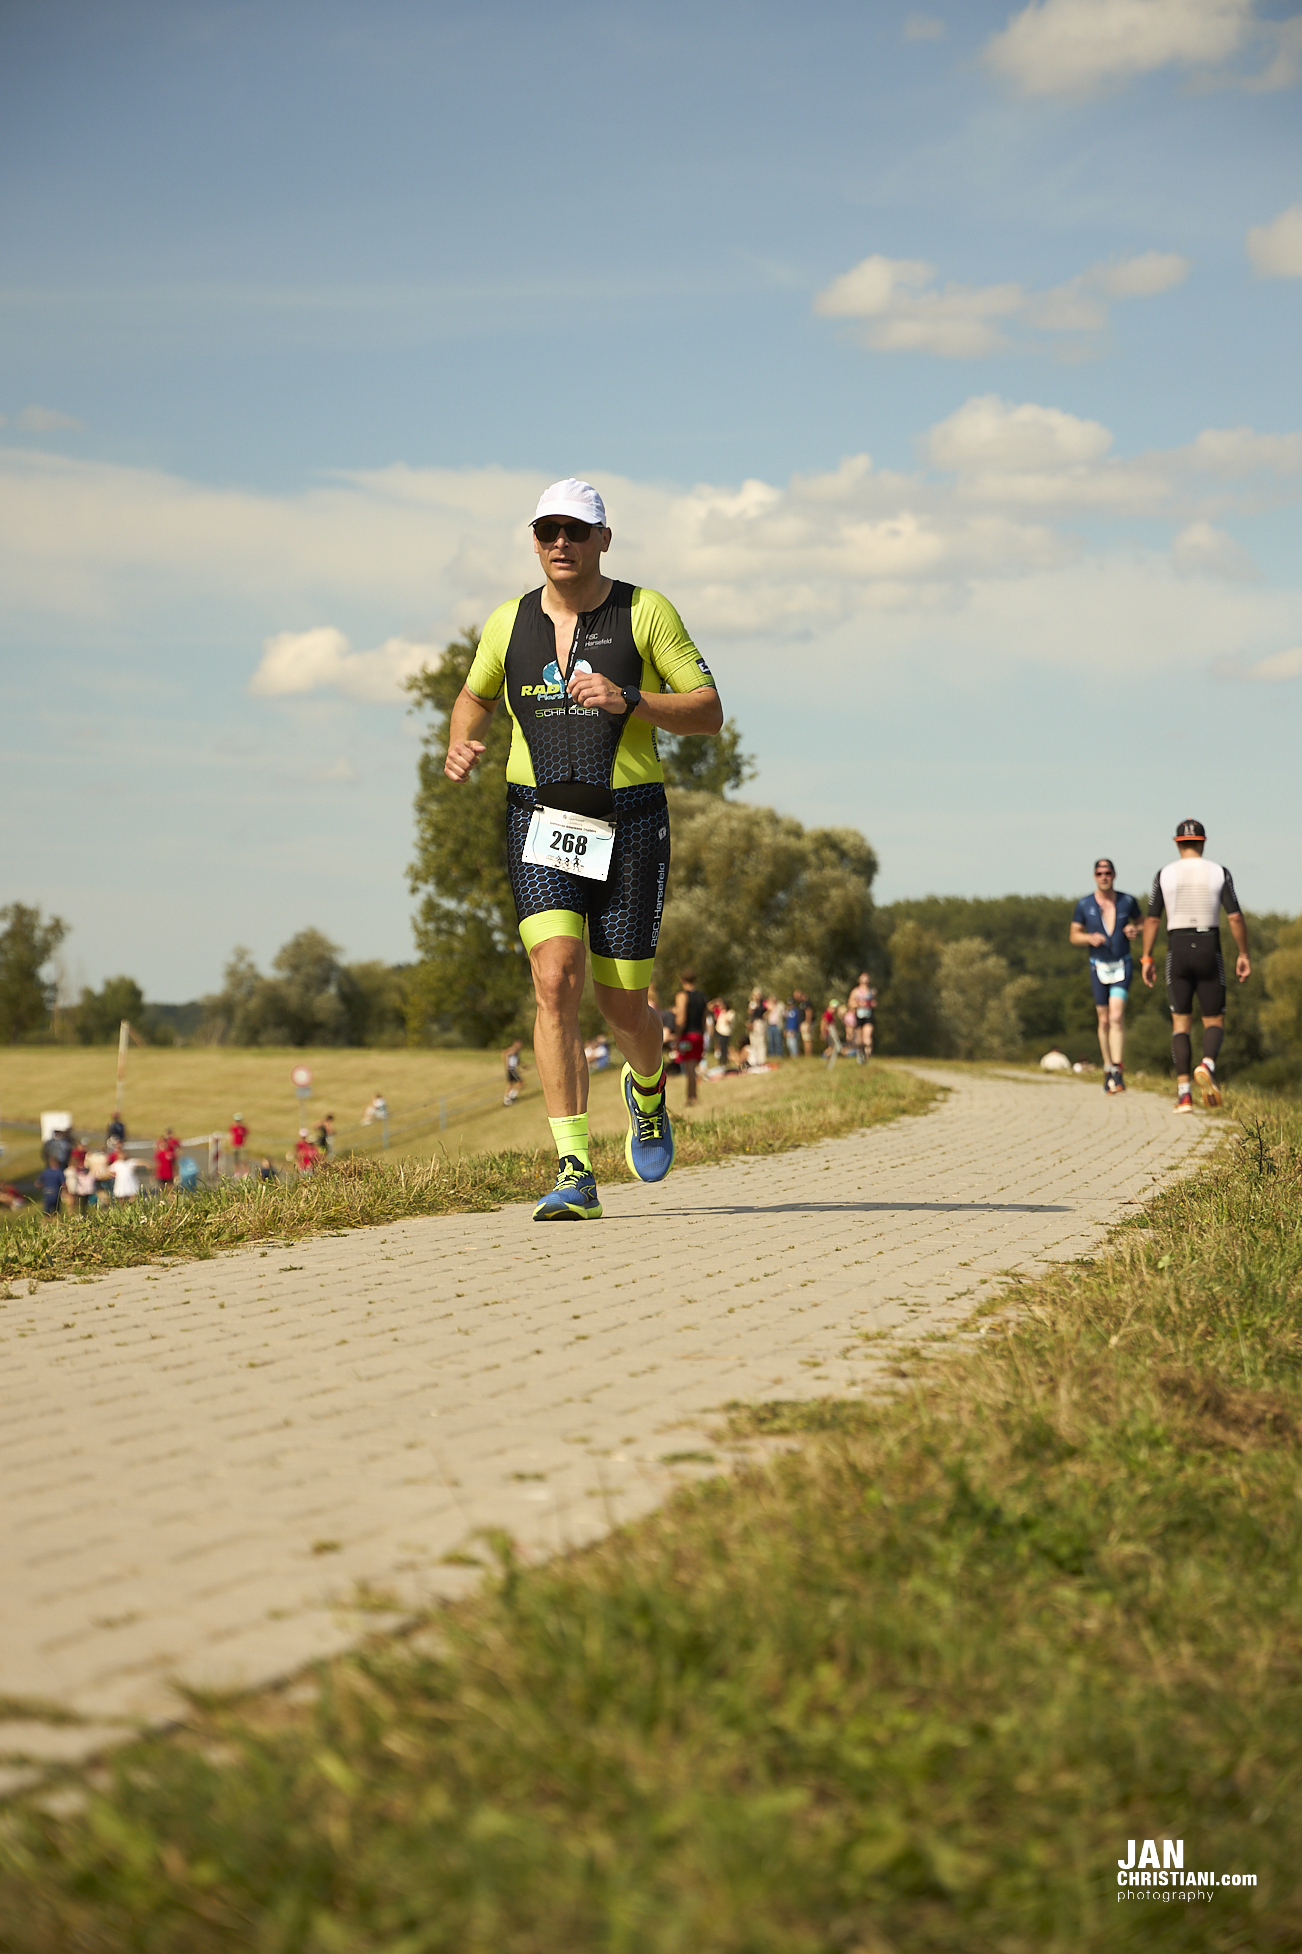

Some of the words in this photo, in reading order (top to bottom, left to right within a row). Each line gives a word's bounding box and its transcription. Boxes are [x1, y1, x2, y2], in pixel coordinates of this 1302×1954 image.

[521, 684, 560, 696] RAD
[550, 830, 588, 856] 268
[654, 862, 665, 919] Harsefeld
[651, 921, 660, 947] RSC
